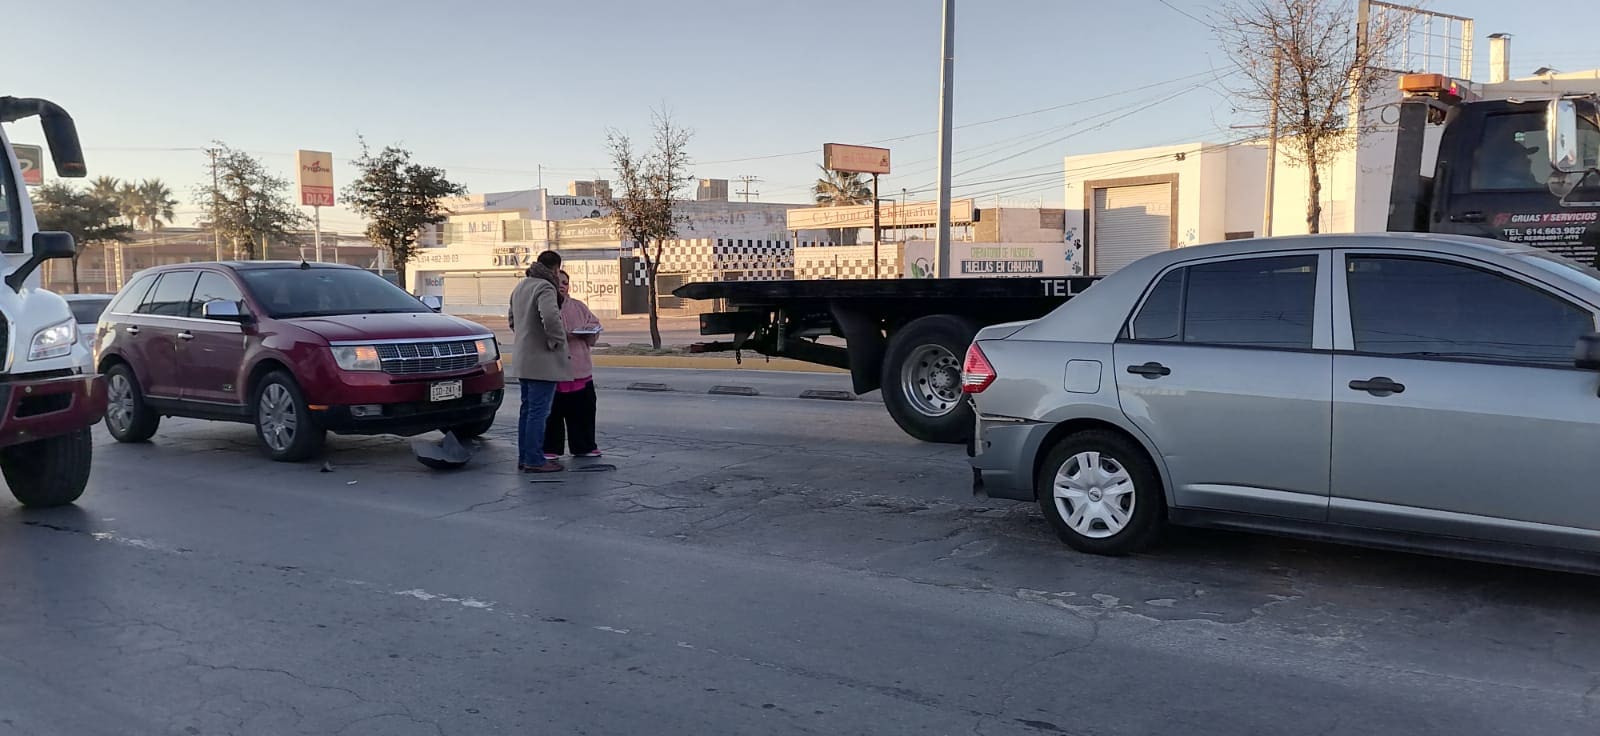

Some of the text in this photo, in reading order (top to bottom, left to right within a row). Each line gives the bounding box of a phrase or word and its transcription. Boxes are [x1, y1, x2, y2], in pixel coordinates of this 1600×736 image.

[306, 193, 330, 205] DIAZ
[553, 197, 593, 206] GORILAS
[1511, 212, 1598, 222] GRUAS Y SERVICIOS
[965, 261, 1039, 272] HUELLAS EN CHIHUAHUA
[1040, 280, 1080, 296] TEL
